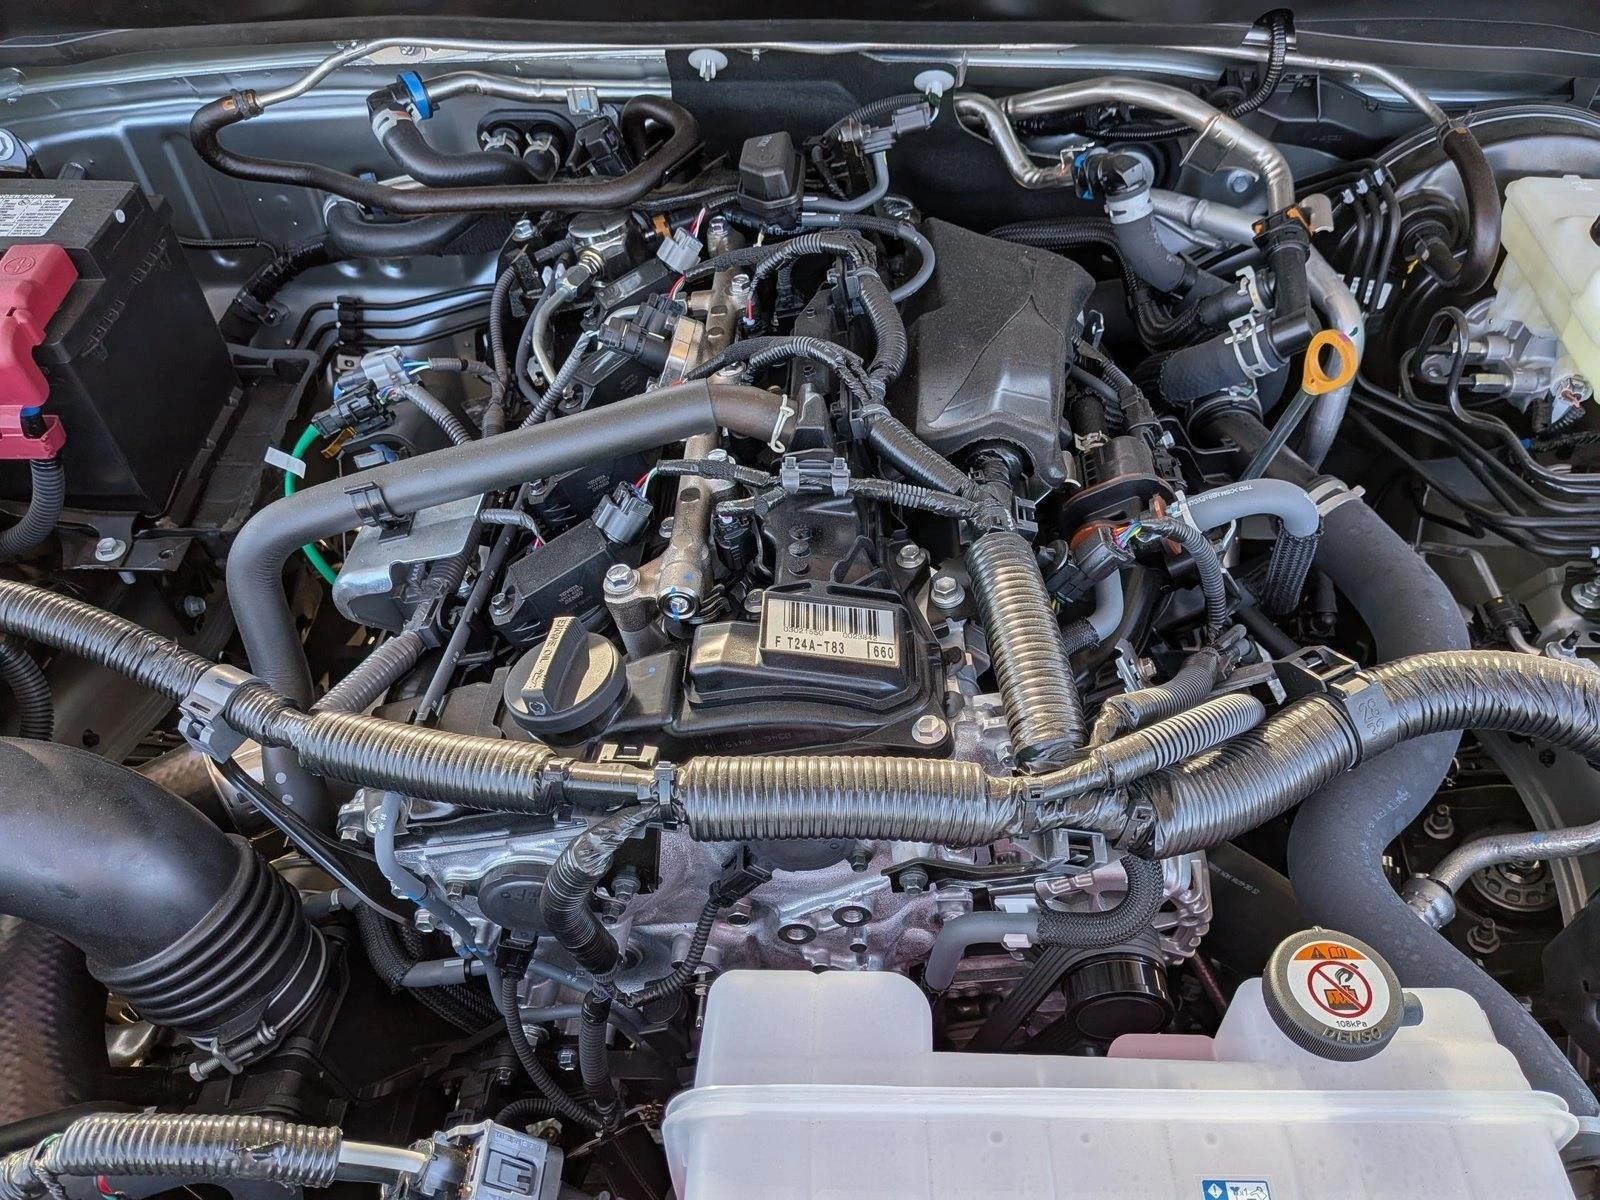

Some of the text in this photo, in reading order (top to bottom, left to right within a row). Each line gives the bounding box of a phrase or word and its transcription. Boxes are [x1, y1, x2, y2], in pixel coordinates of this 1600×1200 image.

[775, 636, 894, 659] F T24A-T83 660
[1336, 1020, 1368, 1028] 108kPa
[1322, 1027, 1382, 1044] DENSO
